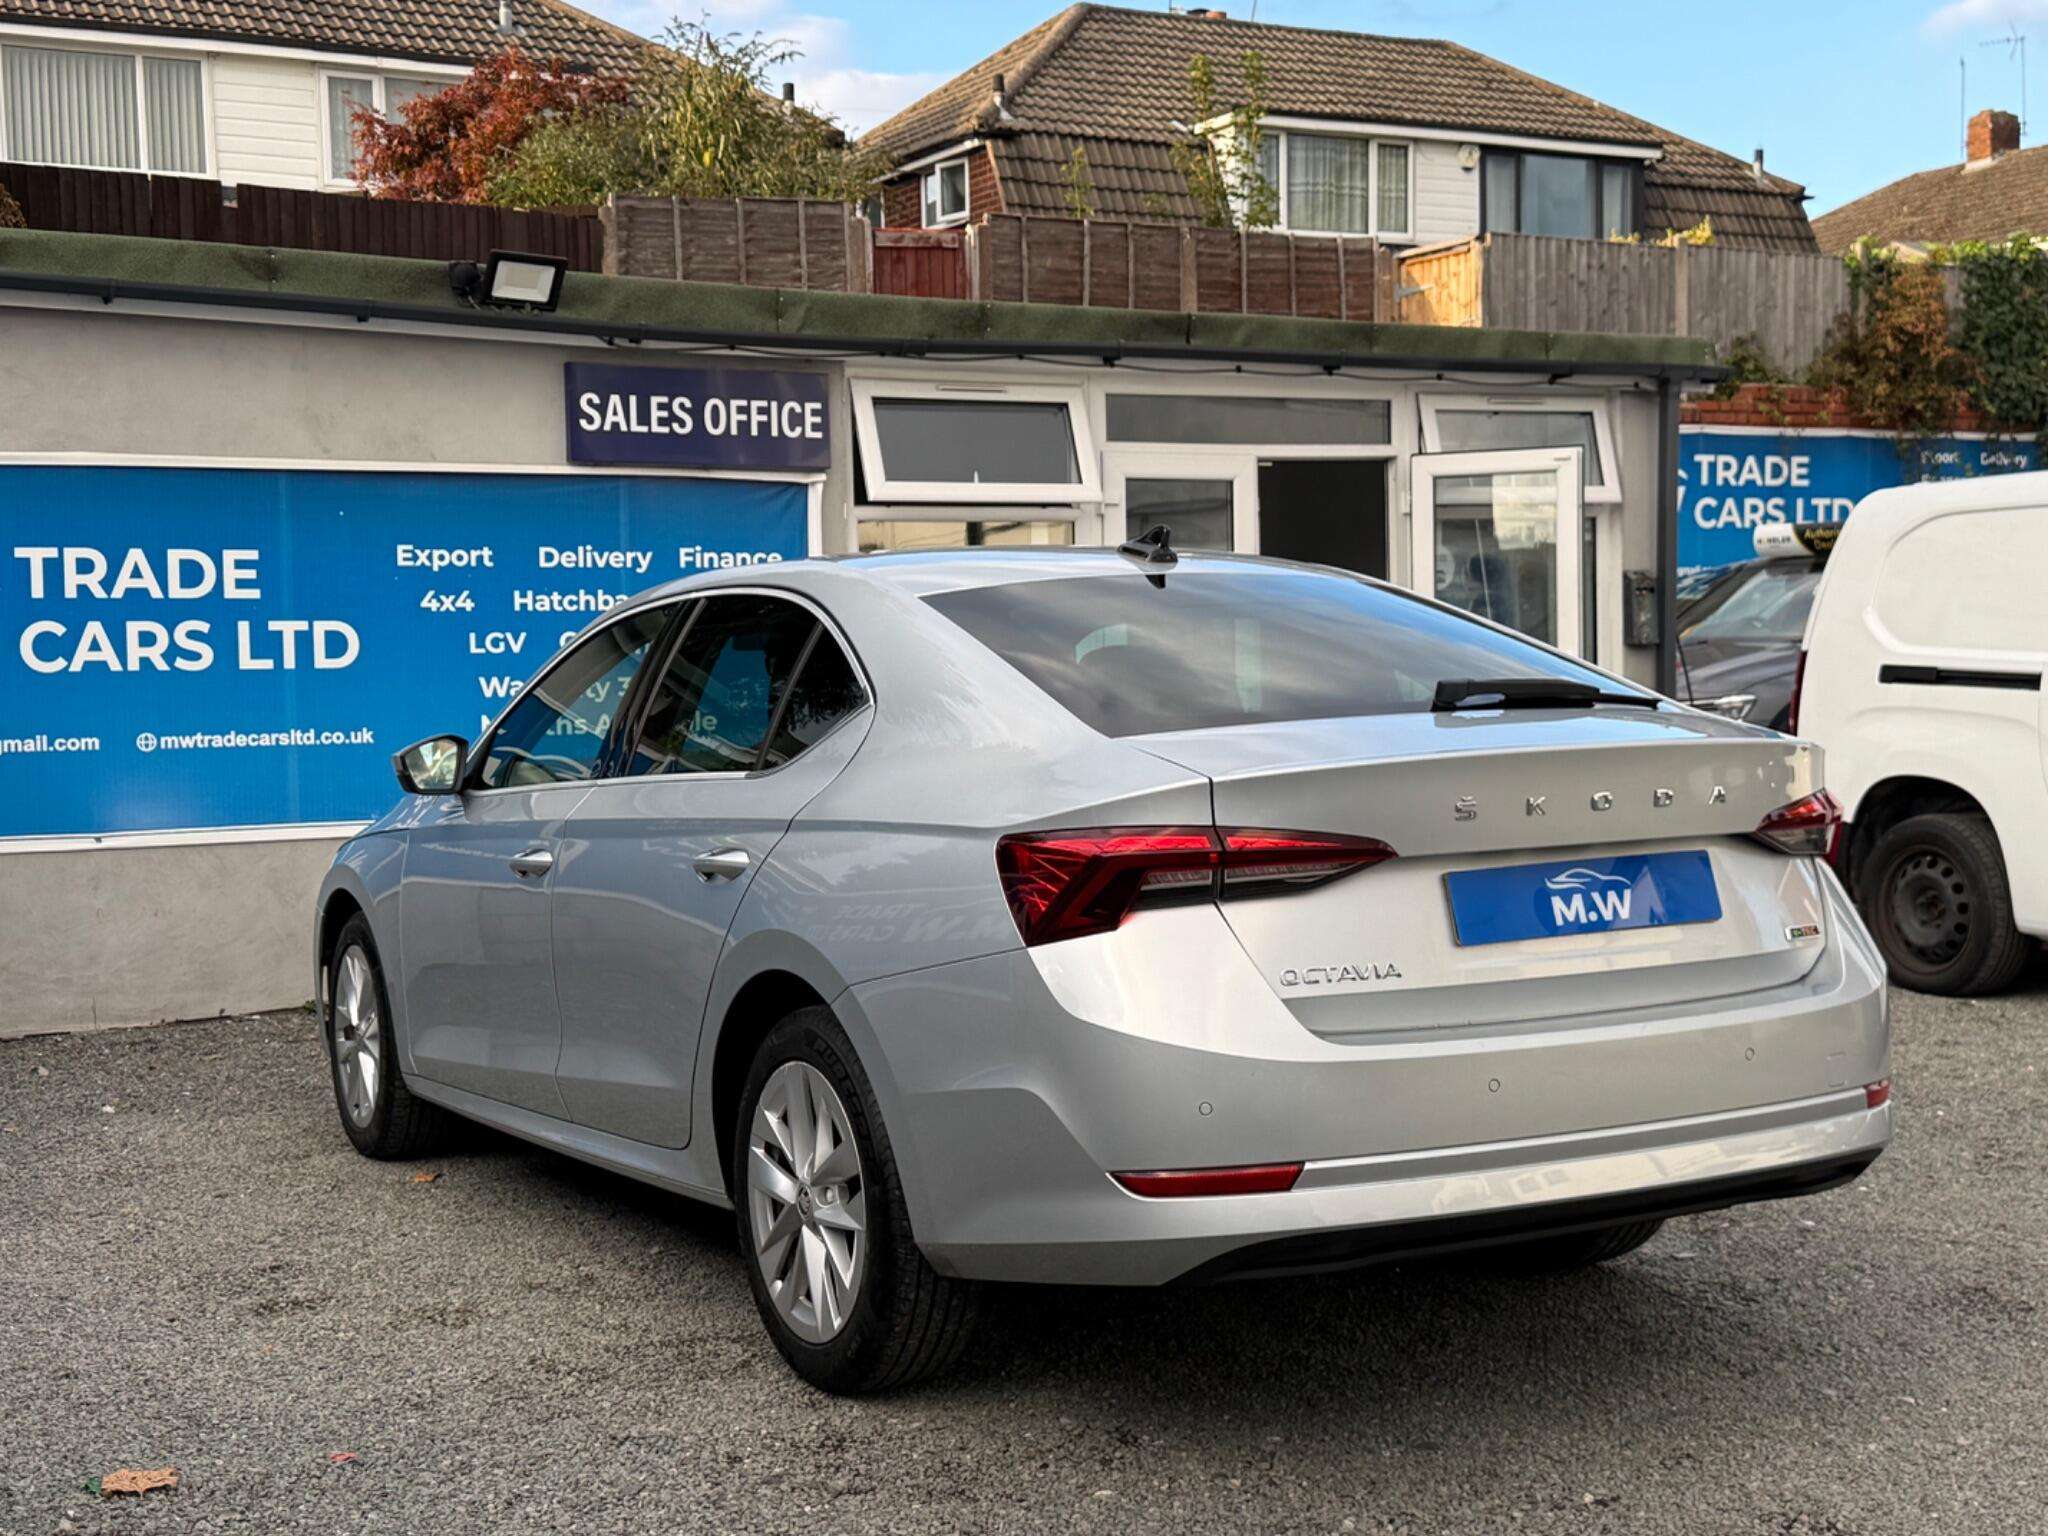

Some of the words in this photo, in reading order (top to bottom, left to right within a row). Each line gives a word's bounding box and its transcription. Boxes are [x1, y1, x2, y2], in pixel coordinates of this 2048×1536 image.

[578, 391, 694, 435] SALES
[703, 397, 823, 439] OFFICE
[1693, 453, 1811, 487] TRADE
[1693, 497, 1787, 530] CARS
[1795, 497, 1854, 525] LTD
[396, 543, 494, 572] Export
[538, 545, 654, 574] Delivery
[14, 546, 262, 600] TRADE
[420, 590, 475, 612] 4x4
[513, 588, 630, 612] Hatchba
[18, 619, 216, 674] CARS
[236, 619, 362, 670] LTD
[468, 631, 527, 654] LGV
[0, 734, 100, 756] mail.com
[159, 727, 375, 750] mwtradecarsltd.co.uk
[1550, 888, 1632, 927] M.W
[1279, 962, 1403, 987] OCTAVIA
